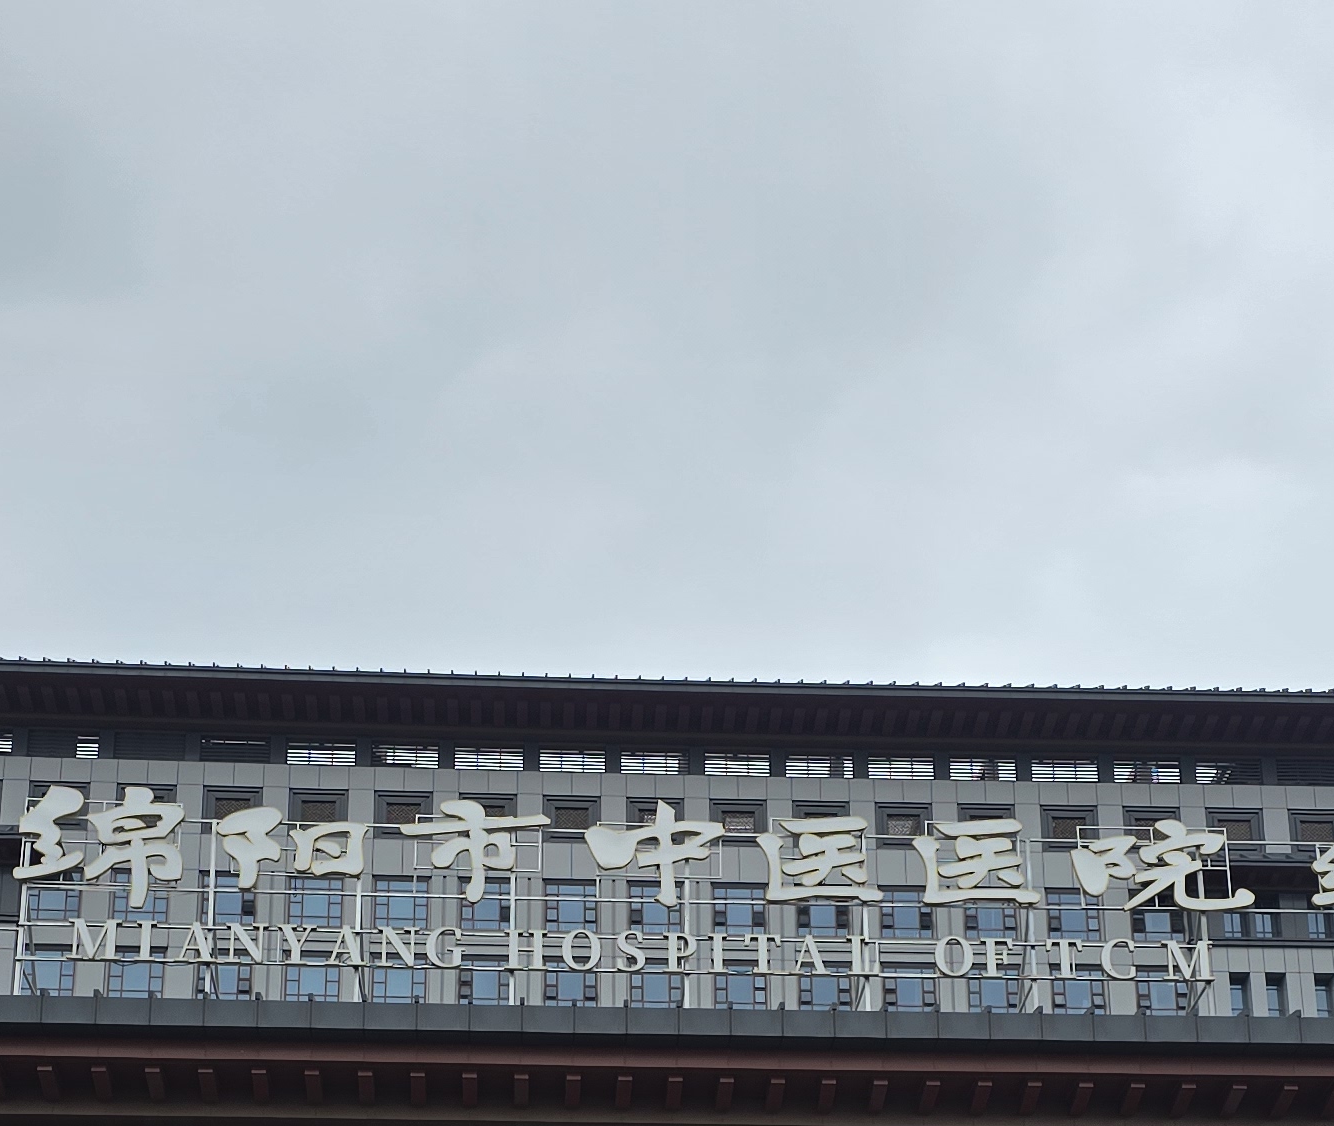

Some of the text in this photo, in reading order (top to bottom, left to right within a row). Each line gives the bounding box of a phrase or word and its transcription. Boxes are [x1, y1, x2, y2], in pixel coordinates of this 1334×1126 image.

[12, 785, 1255, 911] 绵阳市中医医院
[67, 918, 1216, 982] MIANYANG HOSPITAL OF TCM
